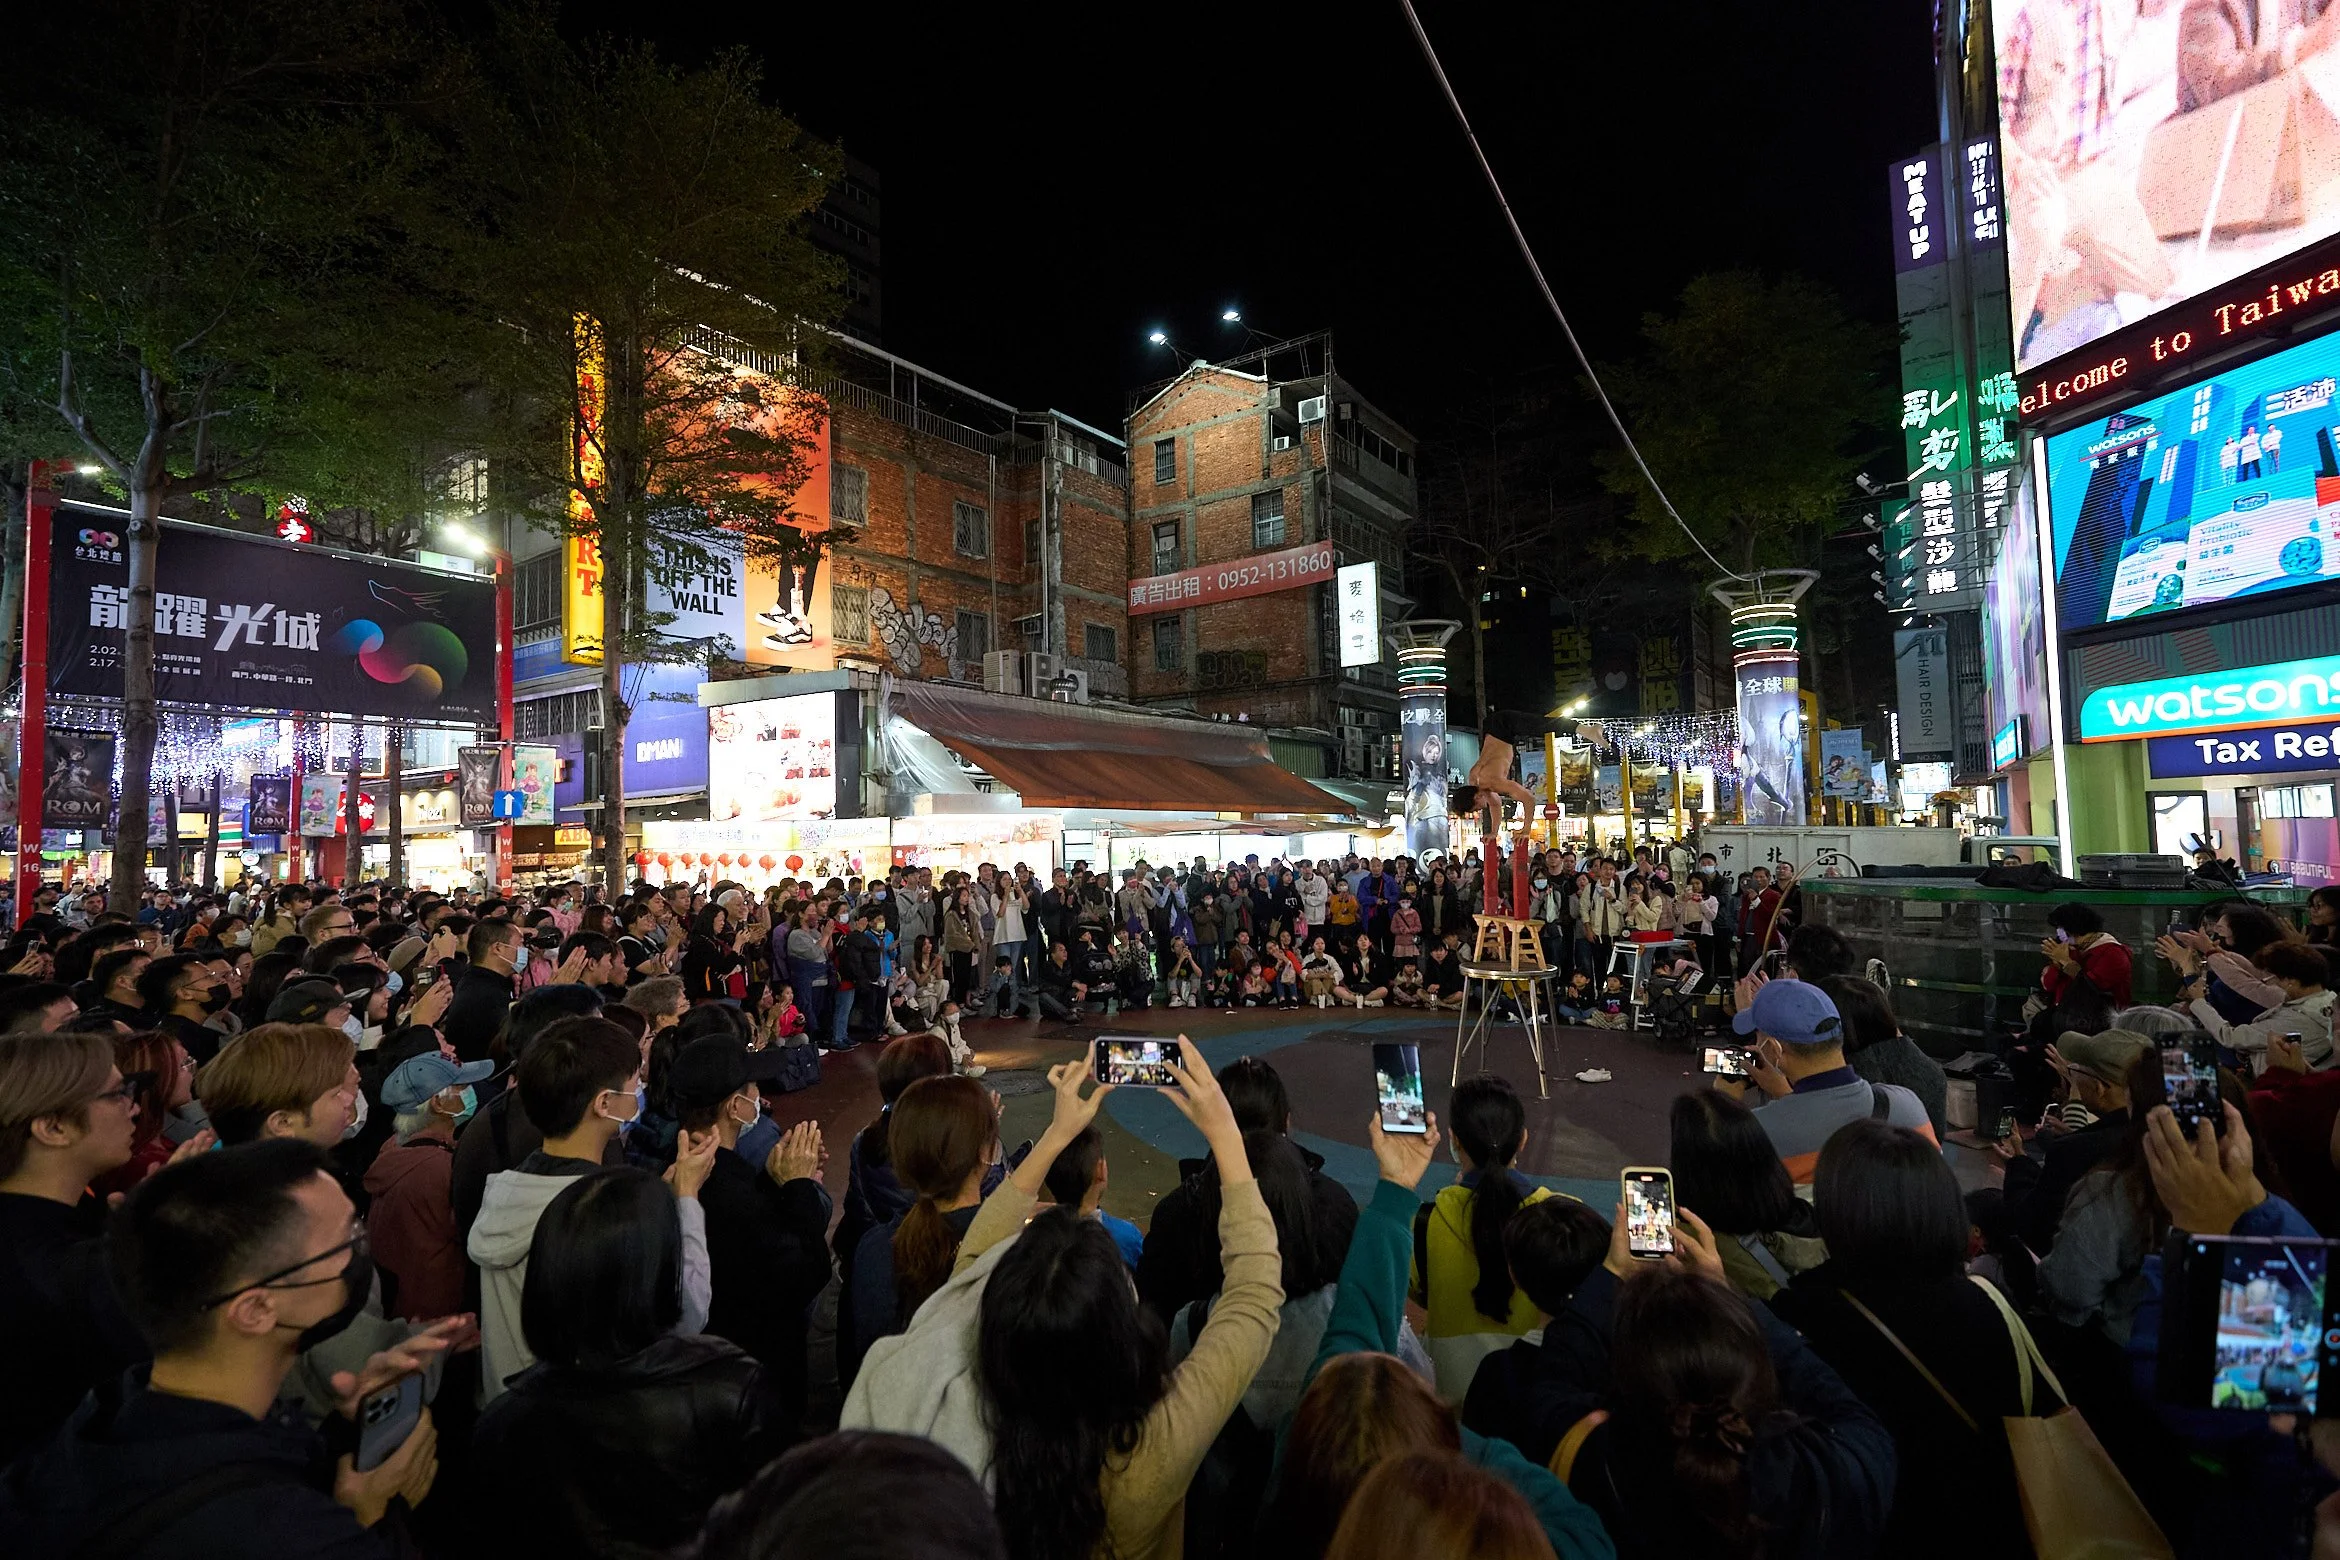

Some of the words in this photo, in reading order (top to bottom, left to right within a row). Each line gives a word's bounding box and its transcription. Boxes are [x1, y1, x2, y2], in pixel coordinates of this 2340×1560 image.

[1903, 161, 1928, 224] MEAT
[1909, 225, 1930, 260] UP
[2151, 332, 2191, 361] to
[2215, 268, 2340, 335] Taiwa
[2087, 423, 2157, 454] watsons
[664, 549, 709, 572] THIS
[714, 554, 732, 576] IS
[658, 566, 695, 590] OFF
[700, 574, 738, 597] THE
[671, 591, 724, 616] WALL
[89, 657, 115, 667] 2.17
[90, 645, 117, 655] 2.02
[1917, 660, 1931, 688] HAIR
[1919, 692, 1934, 738] DESIGN
[2195, 738, 2261, 765] Tax
[1564, 787, 1587, 796] ROM
[46, 800, 101, 815] ROM
[254, 816, 285, 826] ROM
[23, 844, 38, 853] W
[502, 852, 512, 860] 15
[1719, 844, 1734, 860] 市
[1767, 846, 1783, 863] 北
[23, 863, 39, 873] 16
